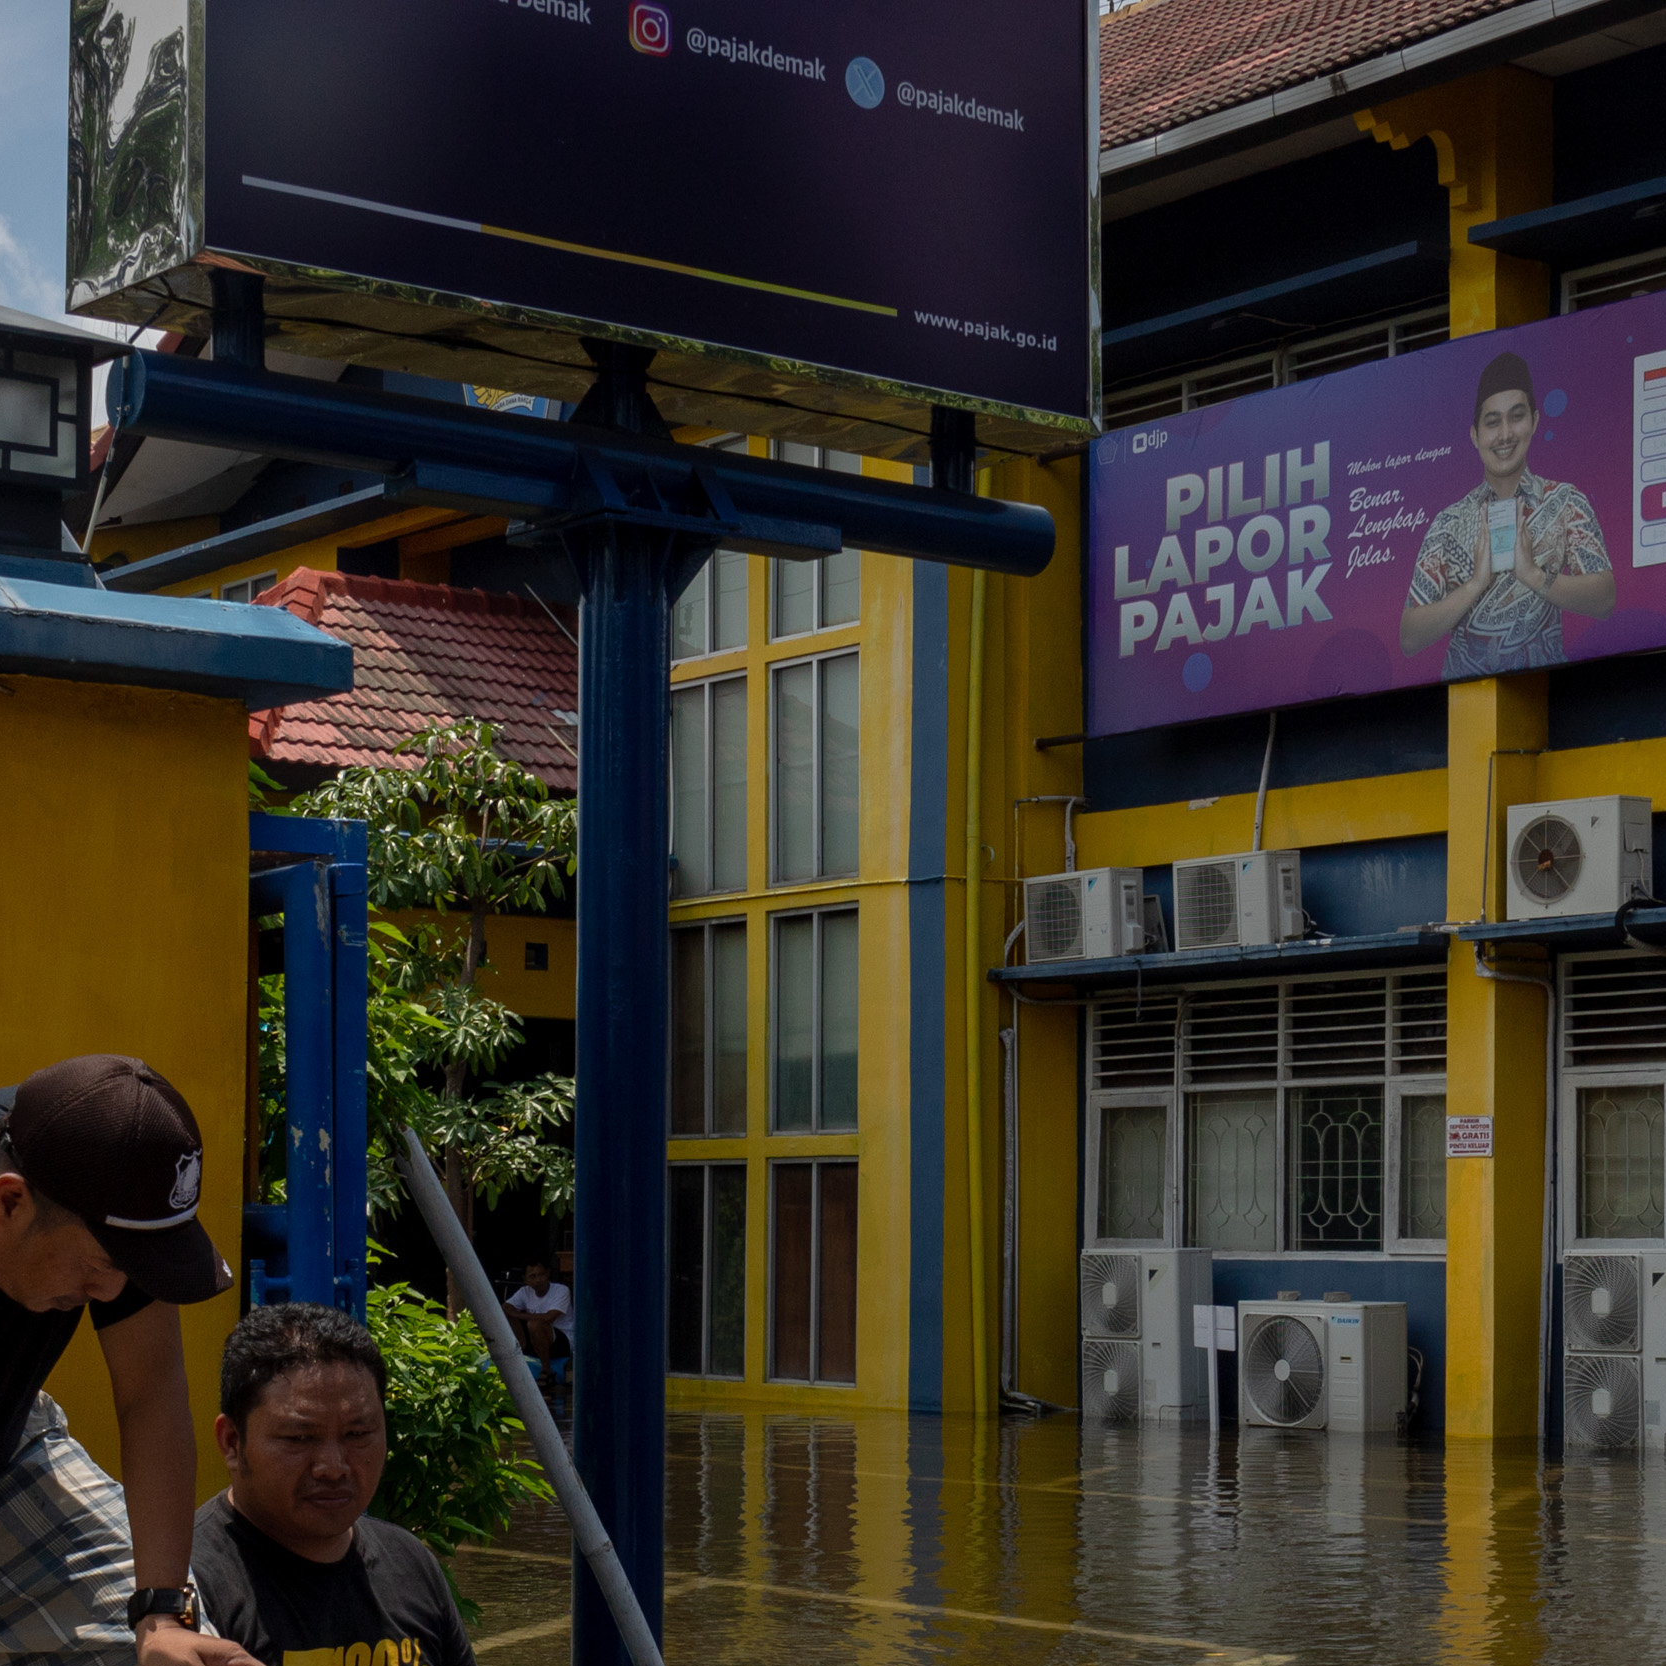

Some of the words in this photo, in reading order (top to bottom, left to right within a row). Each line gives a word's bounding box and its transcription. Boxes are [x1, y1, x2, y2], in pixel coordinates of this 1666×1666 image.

[686, 27, 827, 82] @pajakdemak
[897, 81, 1025, 132] @pajakdemak
[914, 310, 1058, 351] www.pajak.go.id
[1148, 429, 1168, 449] djp
[1347, 458, 1381, 476] Mohon
[1385, 455, 1412, 470] lapor
[1415, 446, 1452, 463] dengan
[1165, 439, 1331, 533] PILIH
[1349, 487, 1405, 512] Benar.
[1347, 506, 1430, 540] Lengkap.
[1114, 504, 1331, 600] LAPOR
[1346, 544, 1396, 579] Jelas.
[1119, 562, 1333, 658] PAJAK
